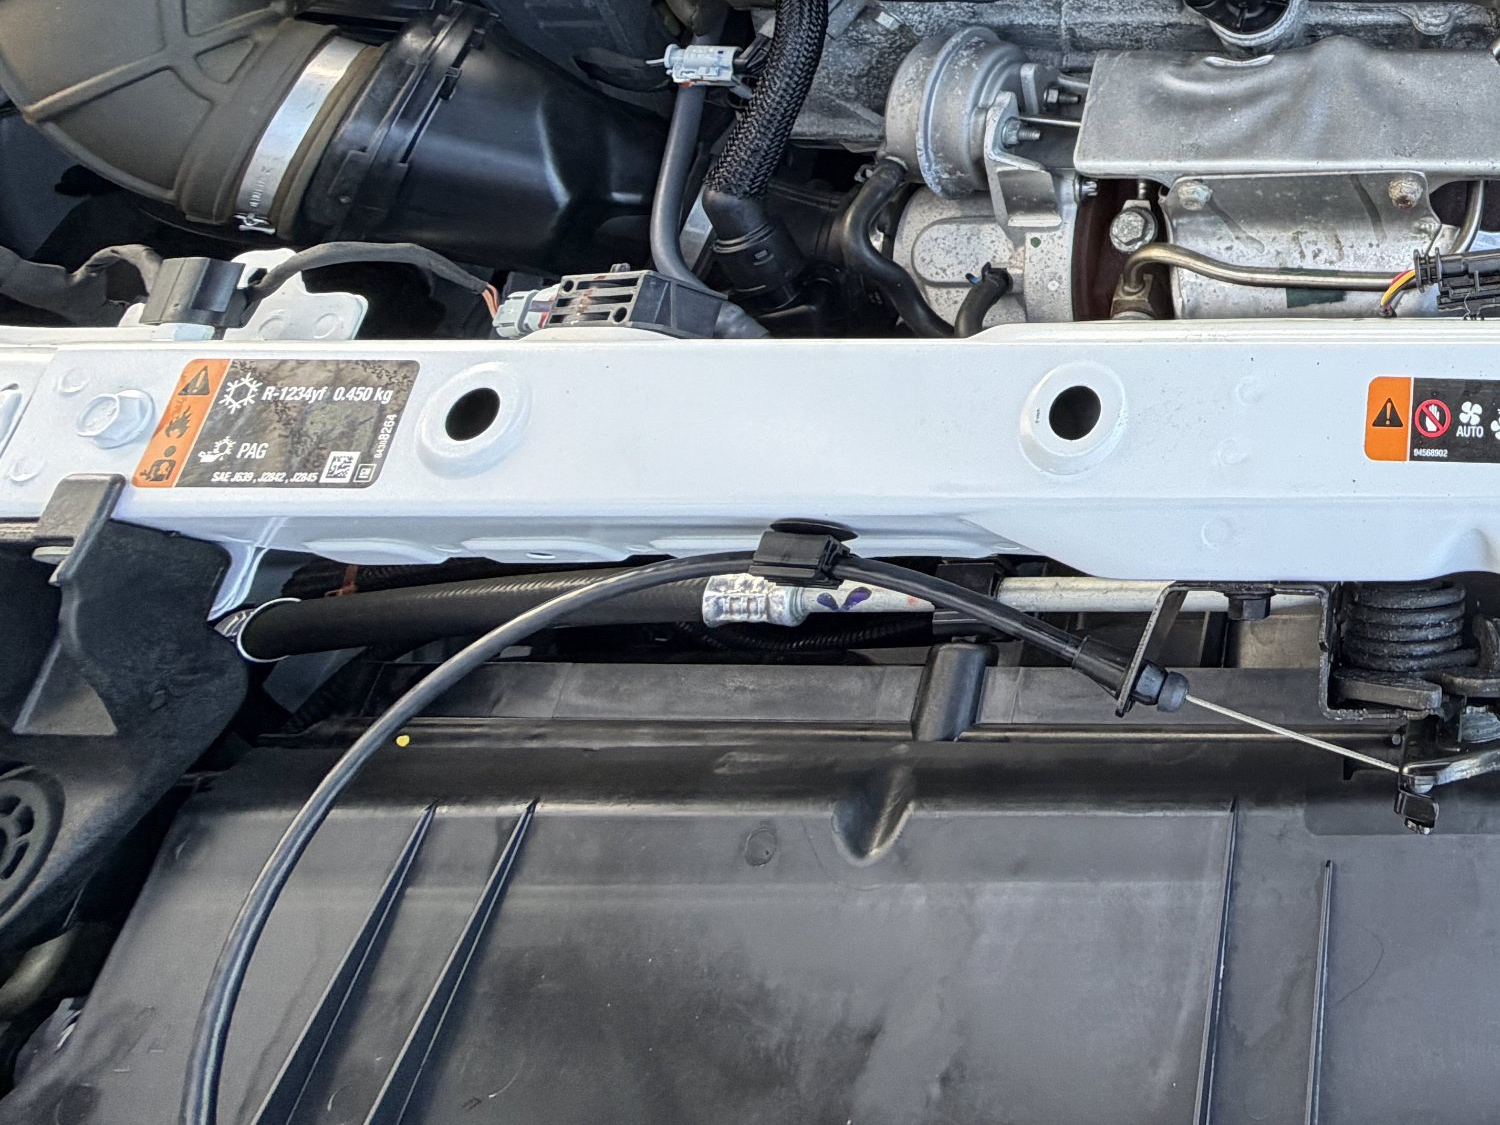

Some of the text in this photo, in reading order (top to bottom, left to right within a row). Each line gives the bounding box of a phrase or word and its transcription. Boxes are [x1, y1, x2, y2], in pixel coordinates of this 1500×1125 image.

[261, 386, 394, 405] R-1234yf 0.450 kg
[1455, 425, 1484, 438] AUTO
[236, 442, 270, 459] PAG
[211, 471, 233, 482] SAE
